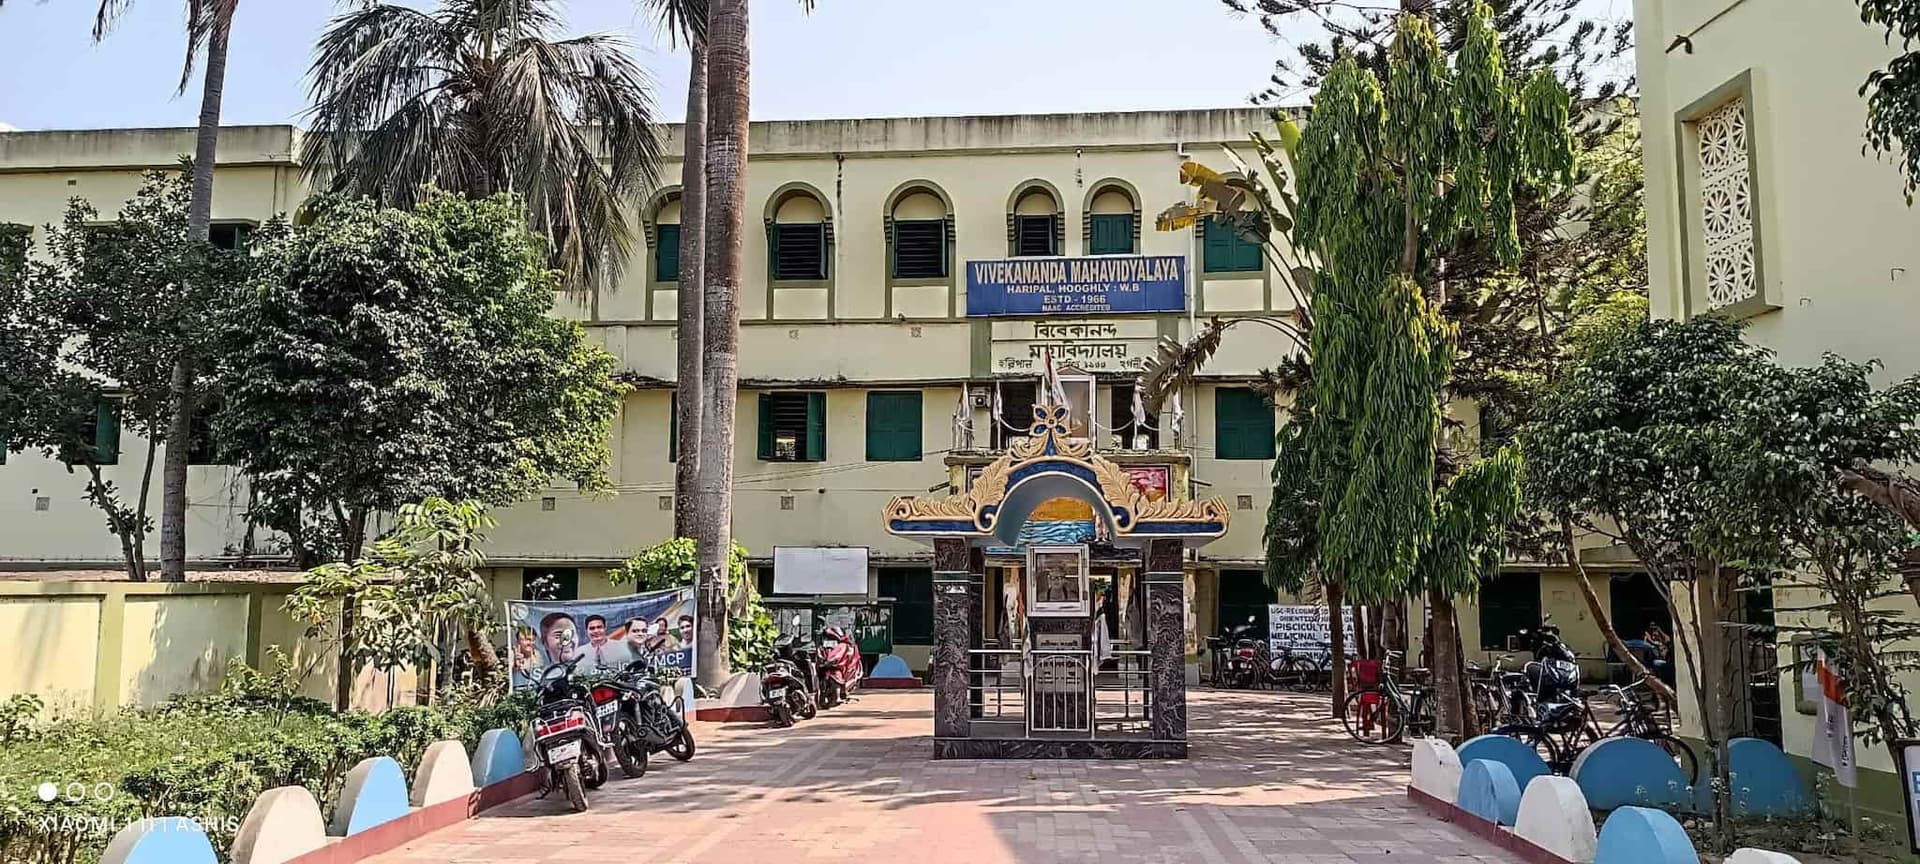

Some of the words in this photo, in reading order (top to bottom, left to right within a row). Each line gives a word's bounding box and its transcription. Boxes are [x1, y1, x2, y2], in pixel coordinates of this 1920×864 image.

[975, 261, 1066, 285] VIVEKANANDA
[1071, 258, 1179, 283] MAHAVIDYALAYA
[1058, 284, 1110, 293] HOOGHLY
[1081, 295, 1106, 304] 1966
[1034, 321, 1117, 338] বিবেকানন্দ
[1275, 623, 1330, 631] PISCICULTU
